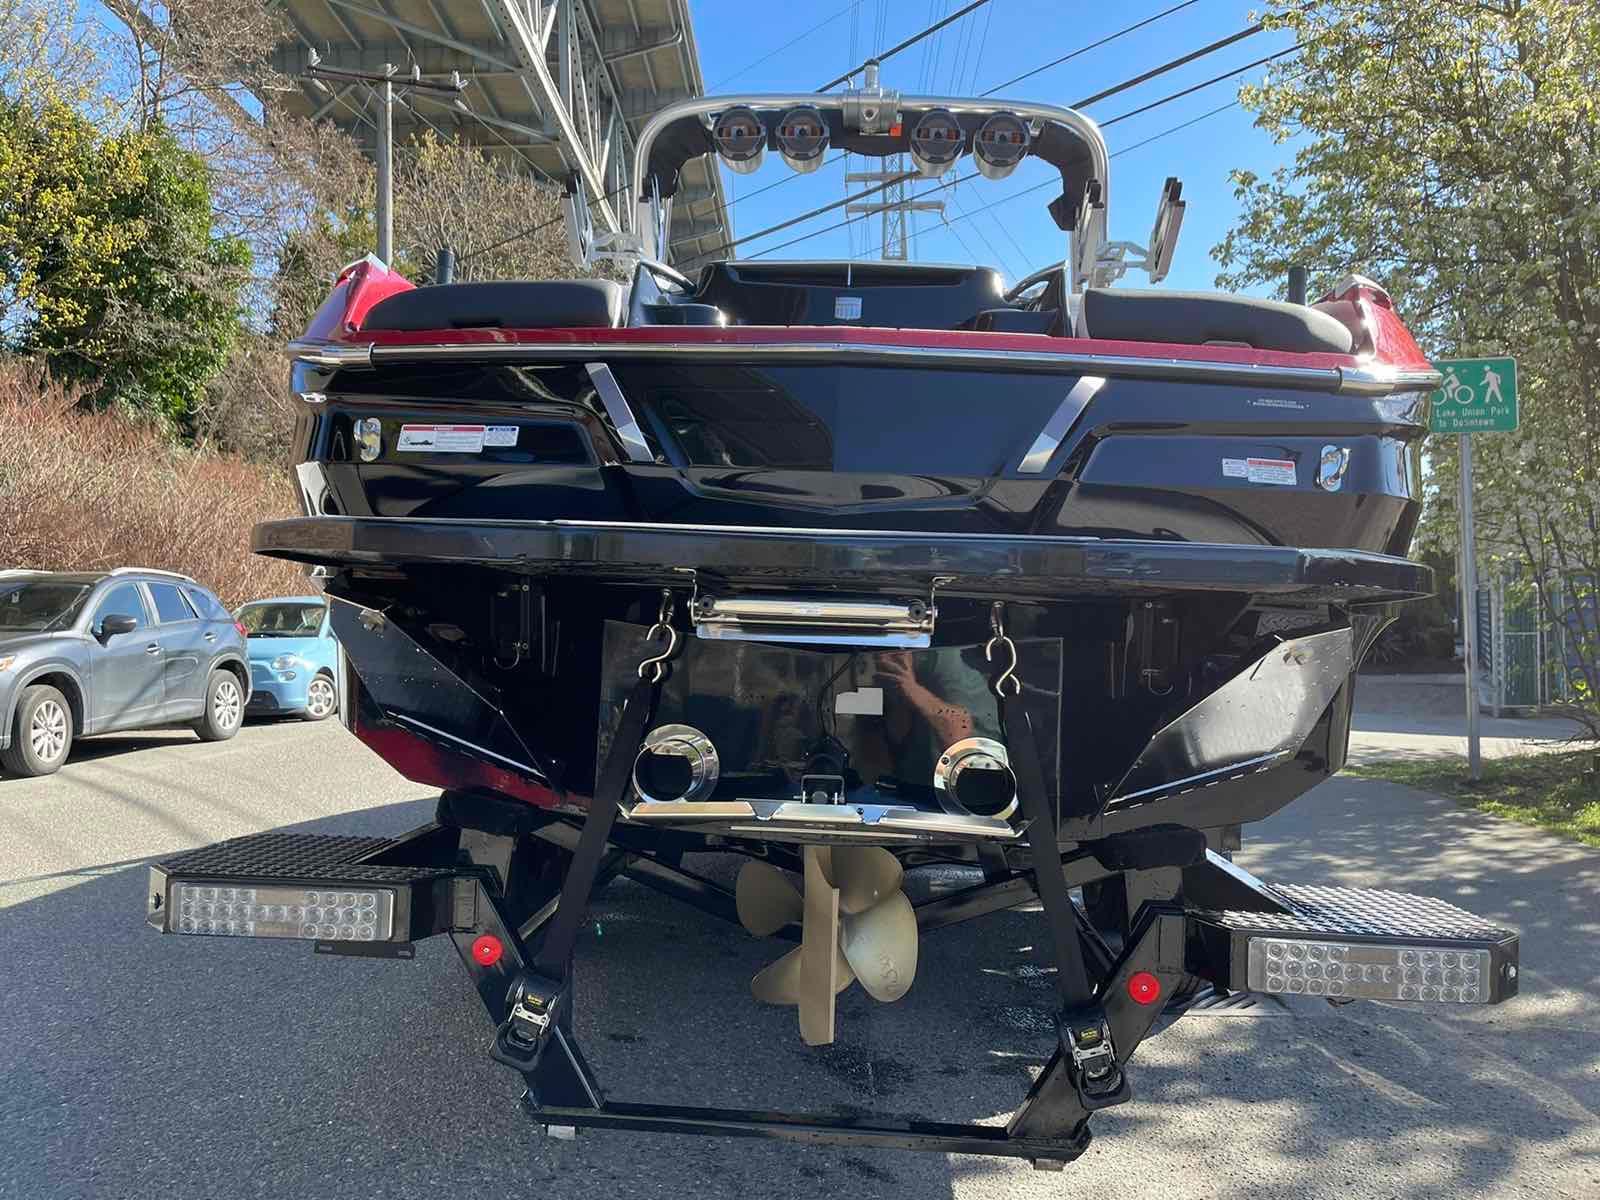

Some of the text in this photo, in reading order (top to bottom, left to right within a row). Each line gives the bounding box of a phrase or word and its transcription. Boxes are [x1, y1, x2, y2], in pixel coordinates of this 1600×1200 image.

[1436, 407, 1510, 417] Lake Union Park
[1453, 418, 1495, 427] Downtown
